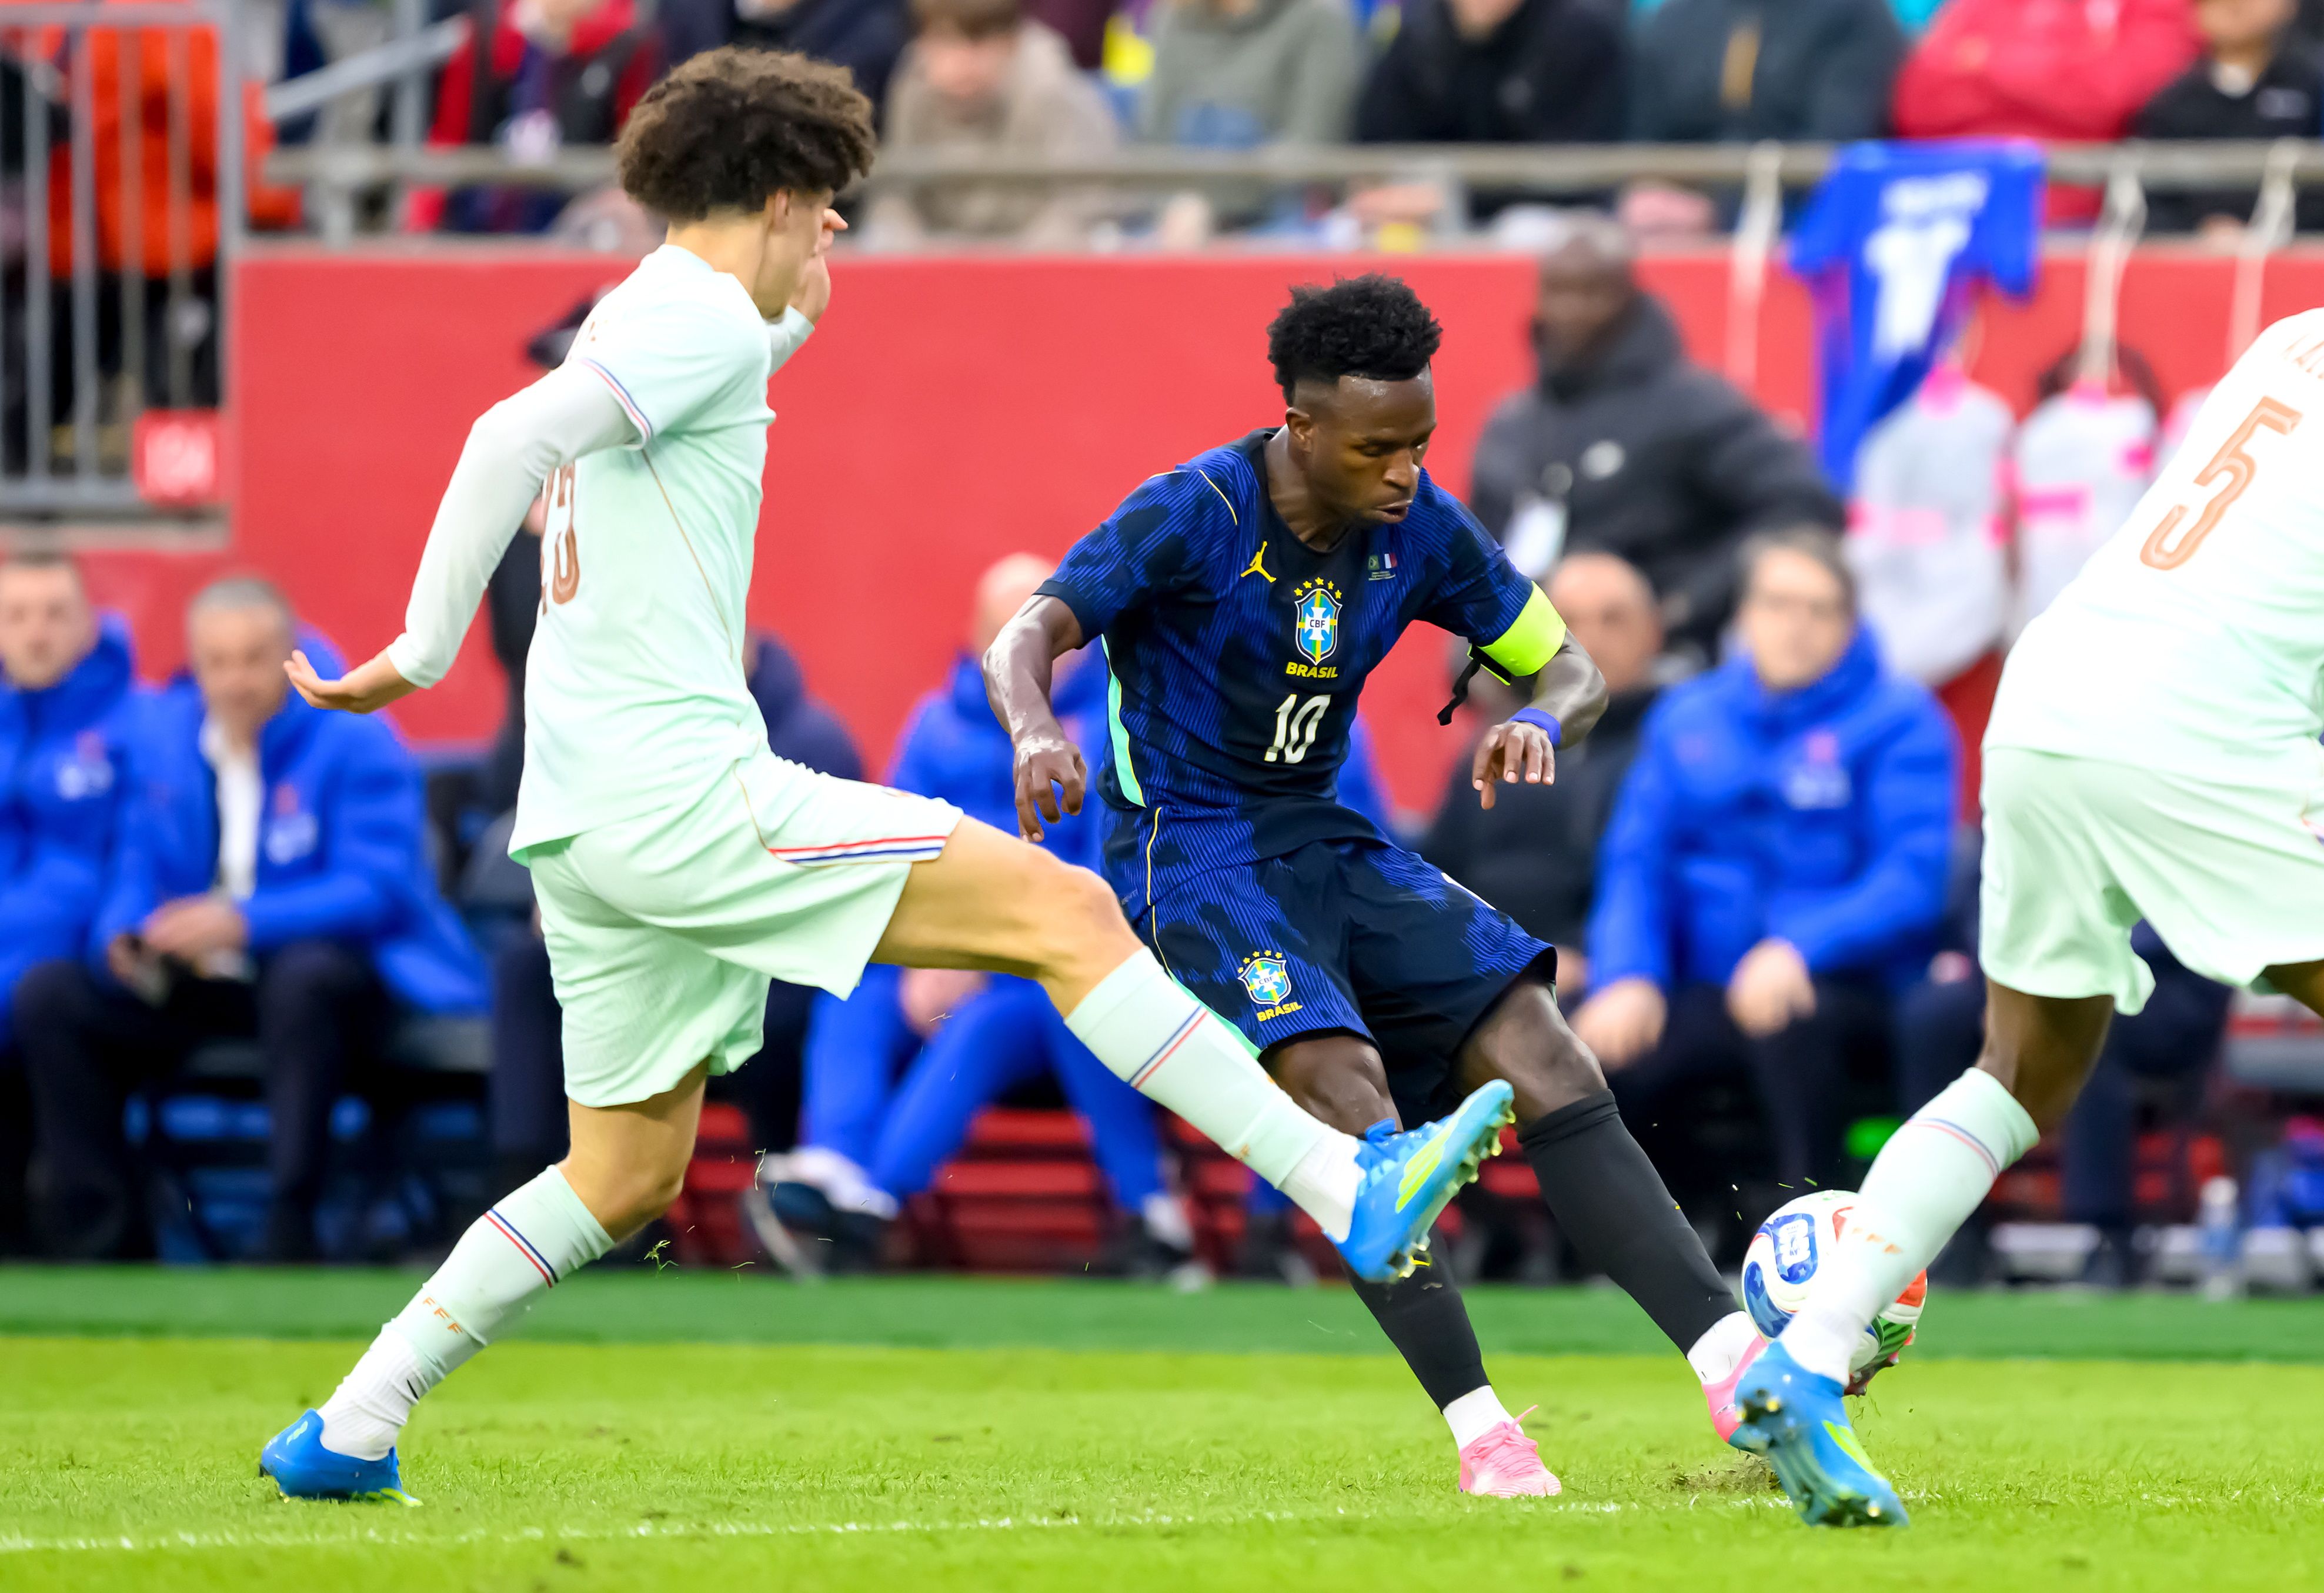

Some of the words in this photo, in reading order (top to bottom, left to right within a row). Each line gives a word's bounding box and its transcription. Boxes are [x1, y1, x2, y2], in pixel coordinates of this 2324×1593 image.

[2140, 395, 2303, 570] 5
[1310, 619, 1325, 628] CBF
[1285, 662, 1338, 678] BRASIL
[1264, 694, 1331, 764] 10
[1258, 976, 1274, 985] CBF
[1257, 1001, 1303, 1022] BRASIL
[423, 1297, 463, 1334] FFF
